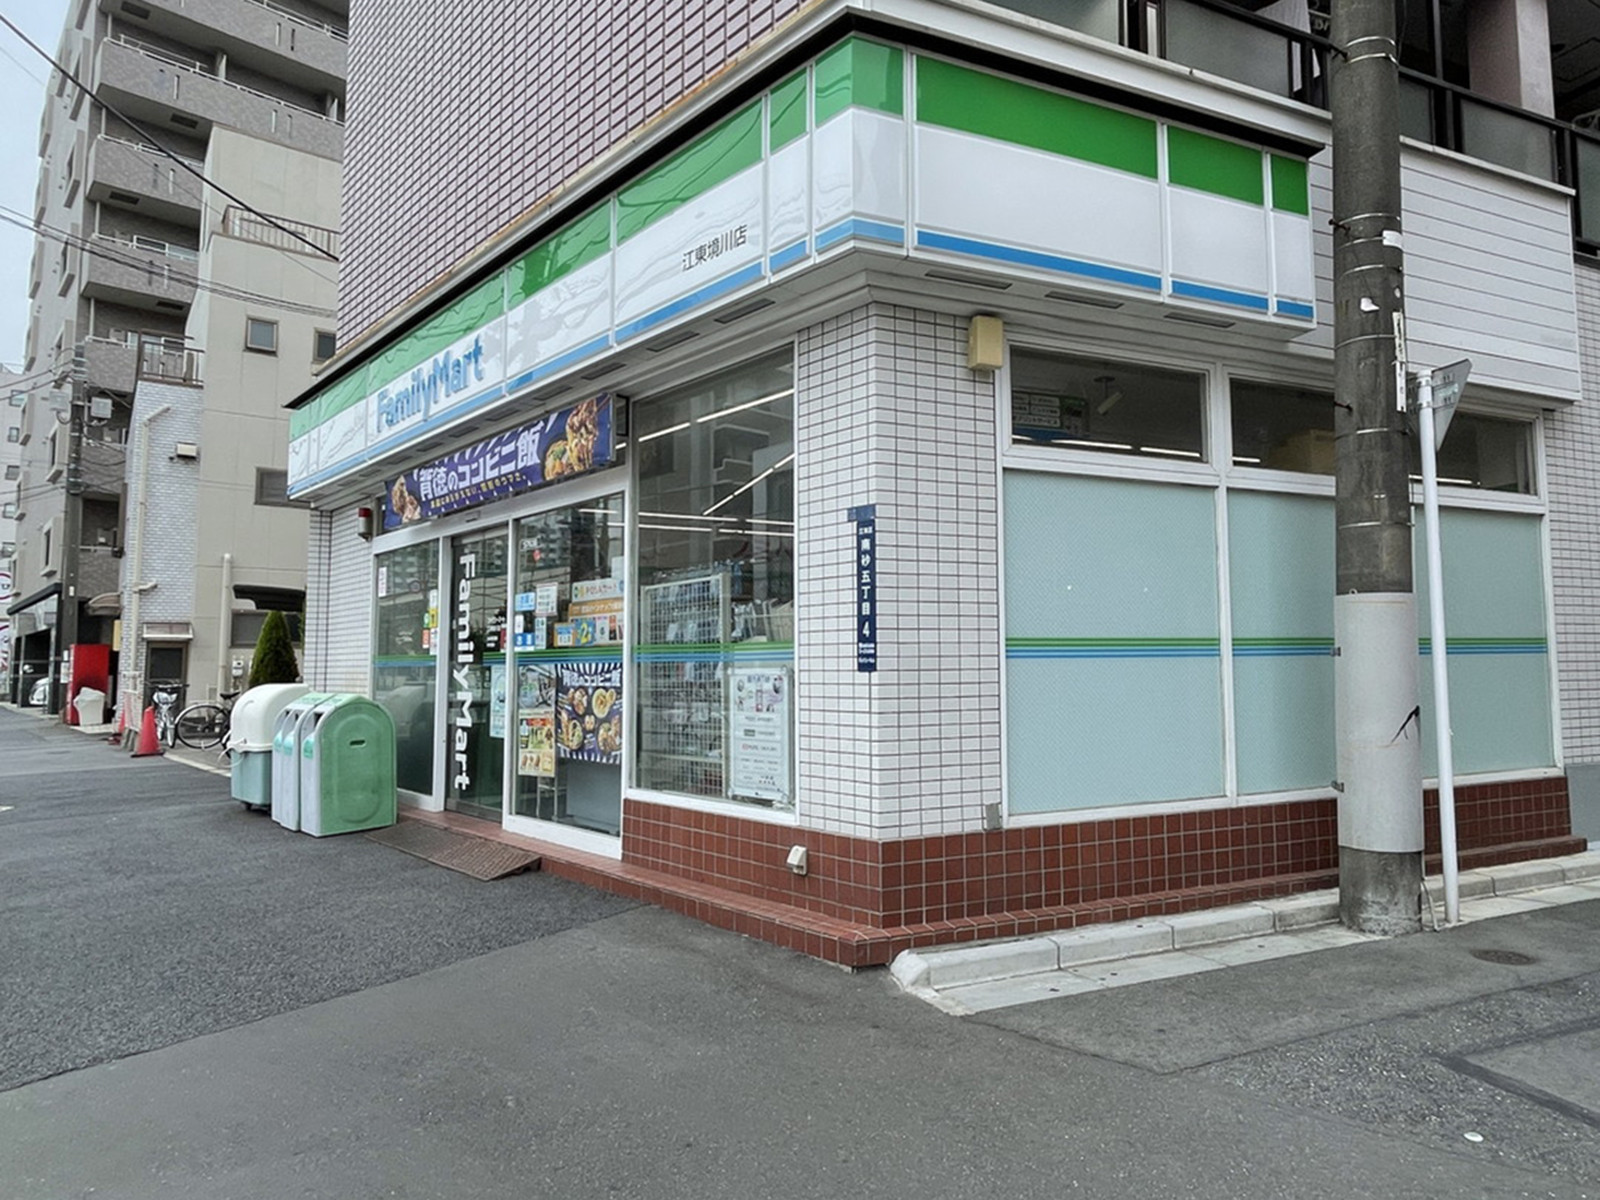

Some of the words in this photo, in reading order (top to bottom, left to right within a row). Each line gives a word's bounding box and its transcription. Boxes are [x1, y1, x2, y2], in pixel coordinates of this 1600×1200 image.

[376, 333, 484, 434] FamilyMart
[419, 423, 542, 502] 背徳のコンビニ飯
[452, 553, 476, 791] FamilyMart
